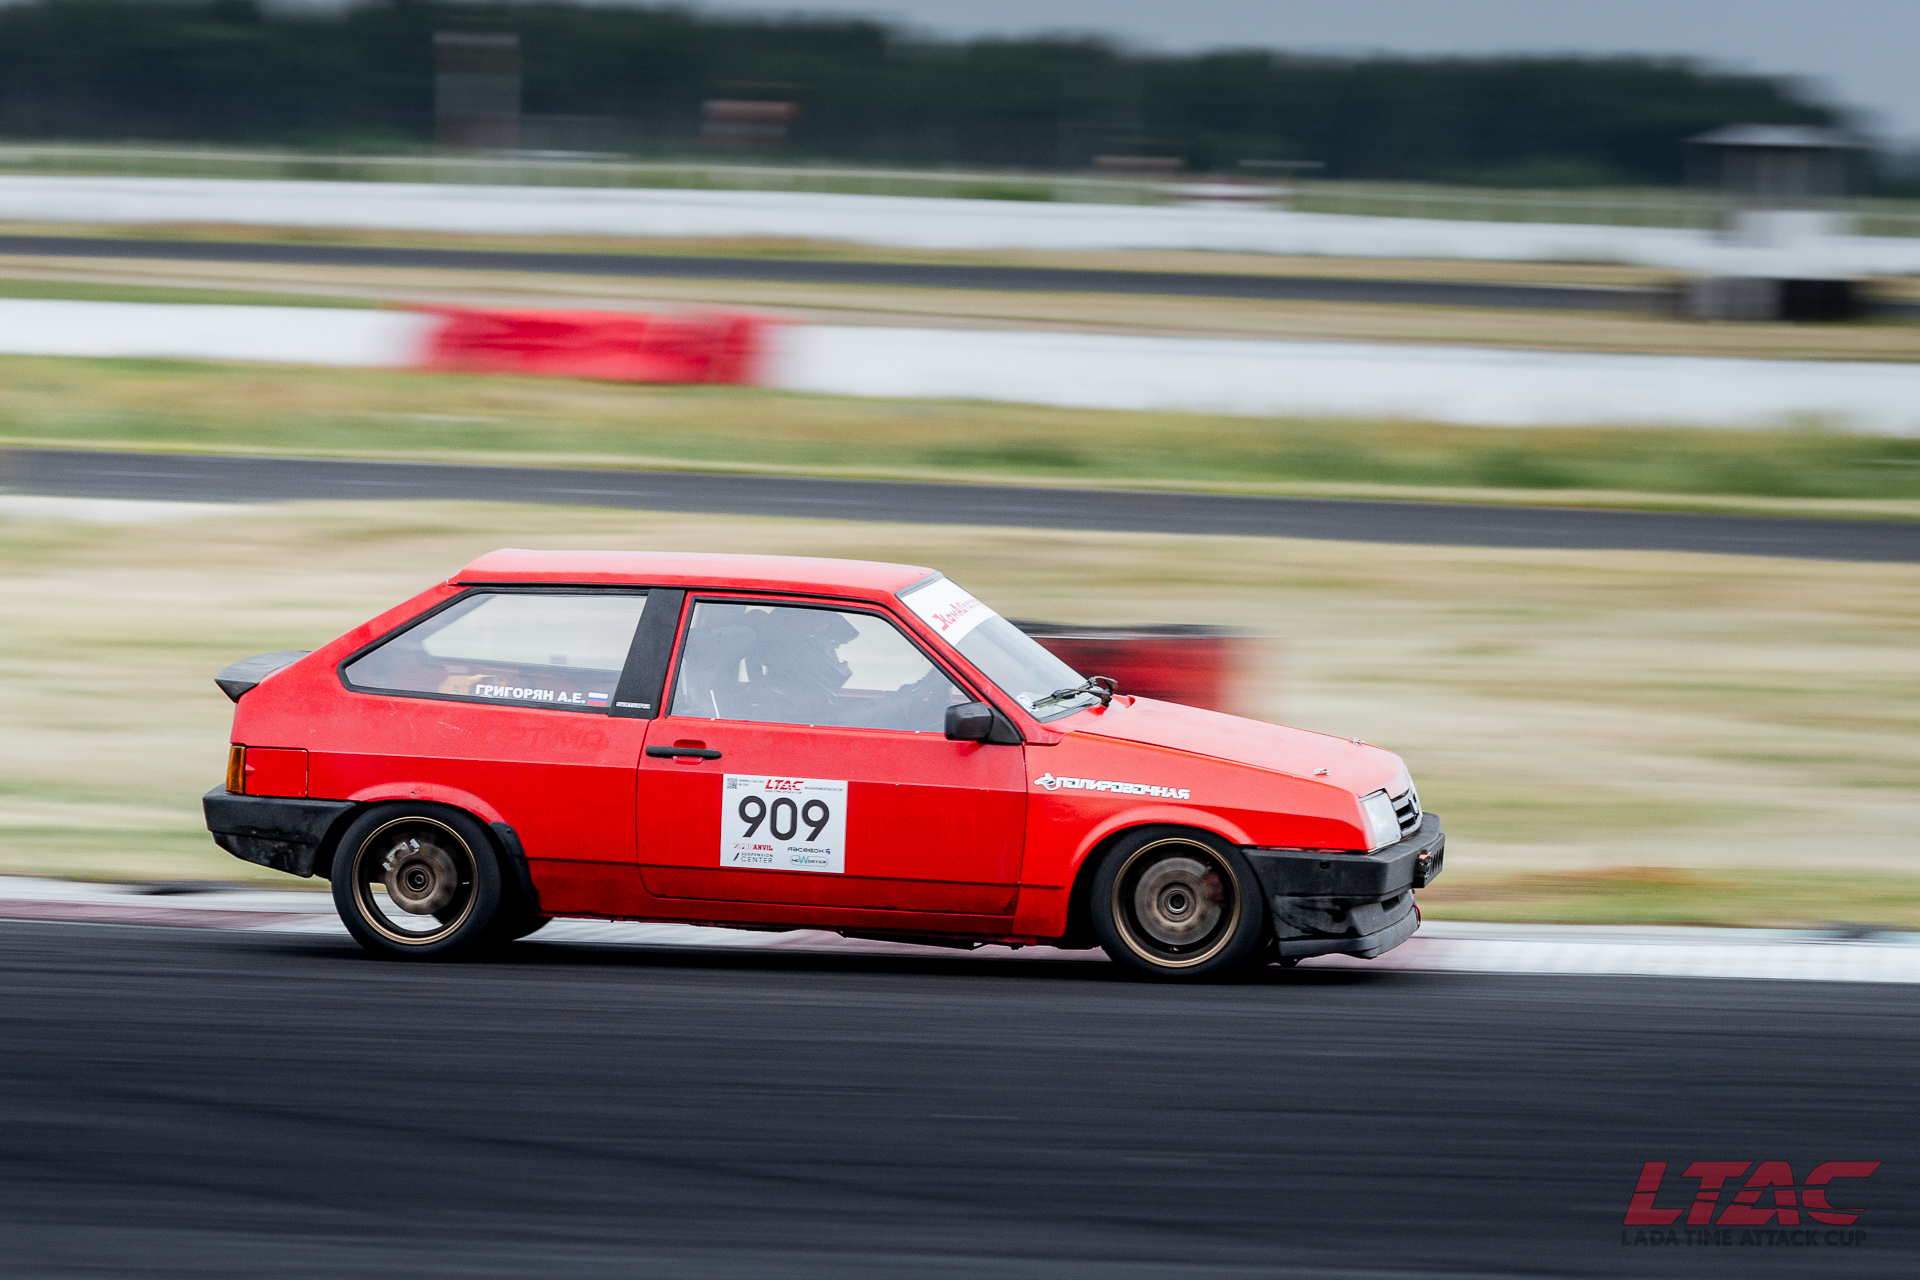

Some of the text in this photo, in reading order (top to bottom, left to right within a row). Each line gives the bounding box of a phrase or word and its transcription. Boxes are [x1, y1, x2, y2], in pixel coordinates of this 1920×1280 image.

[475, 684, 586, 704] ГРИГОРЯН А.Е.
[765, 779, 805, 791] LTAC
[1056, 776, 1191, 800] ПОЛИРОВОЧНАЯ
[739, 795, 830, 842] 909
[741, 856, 773, 864] CENTER
